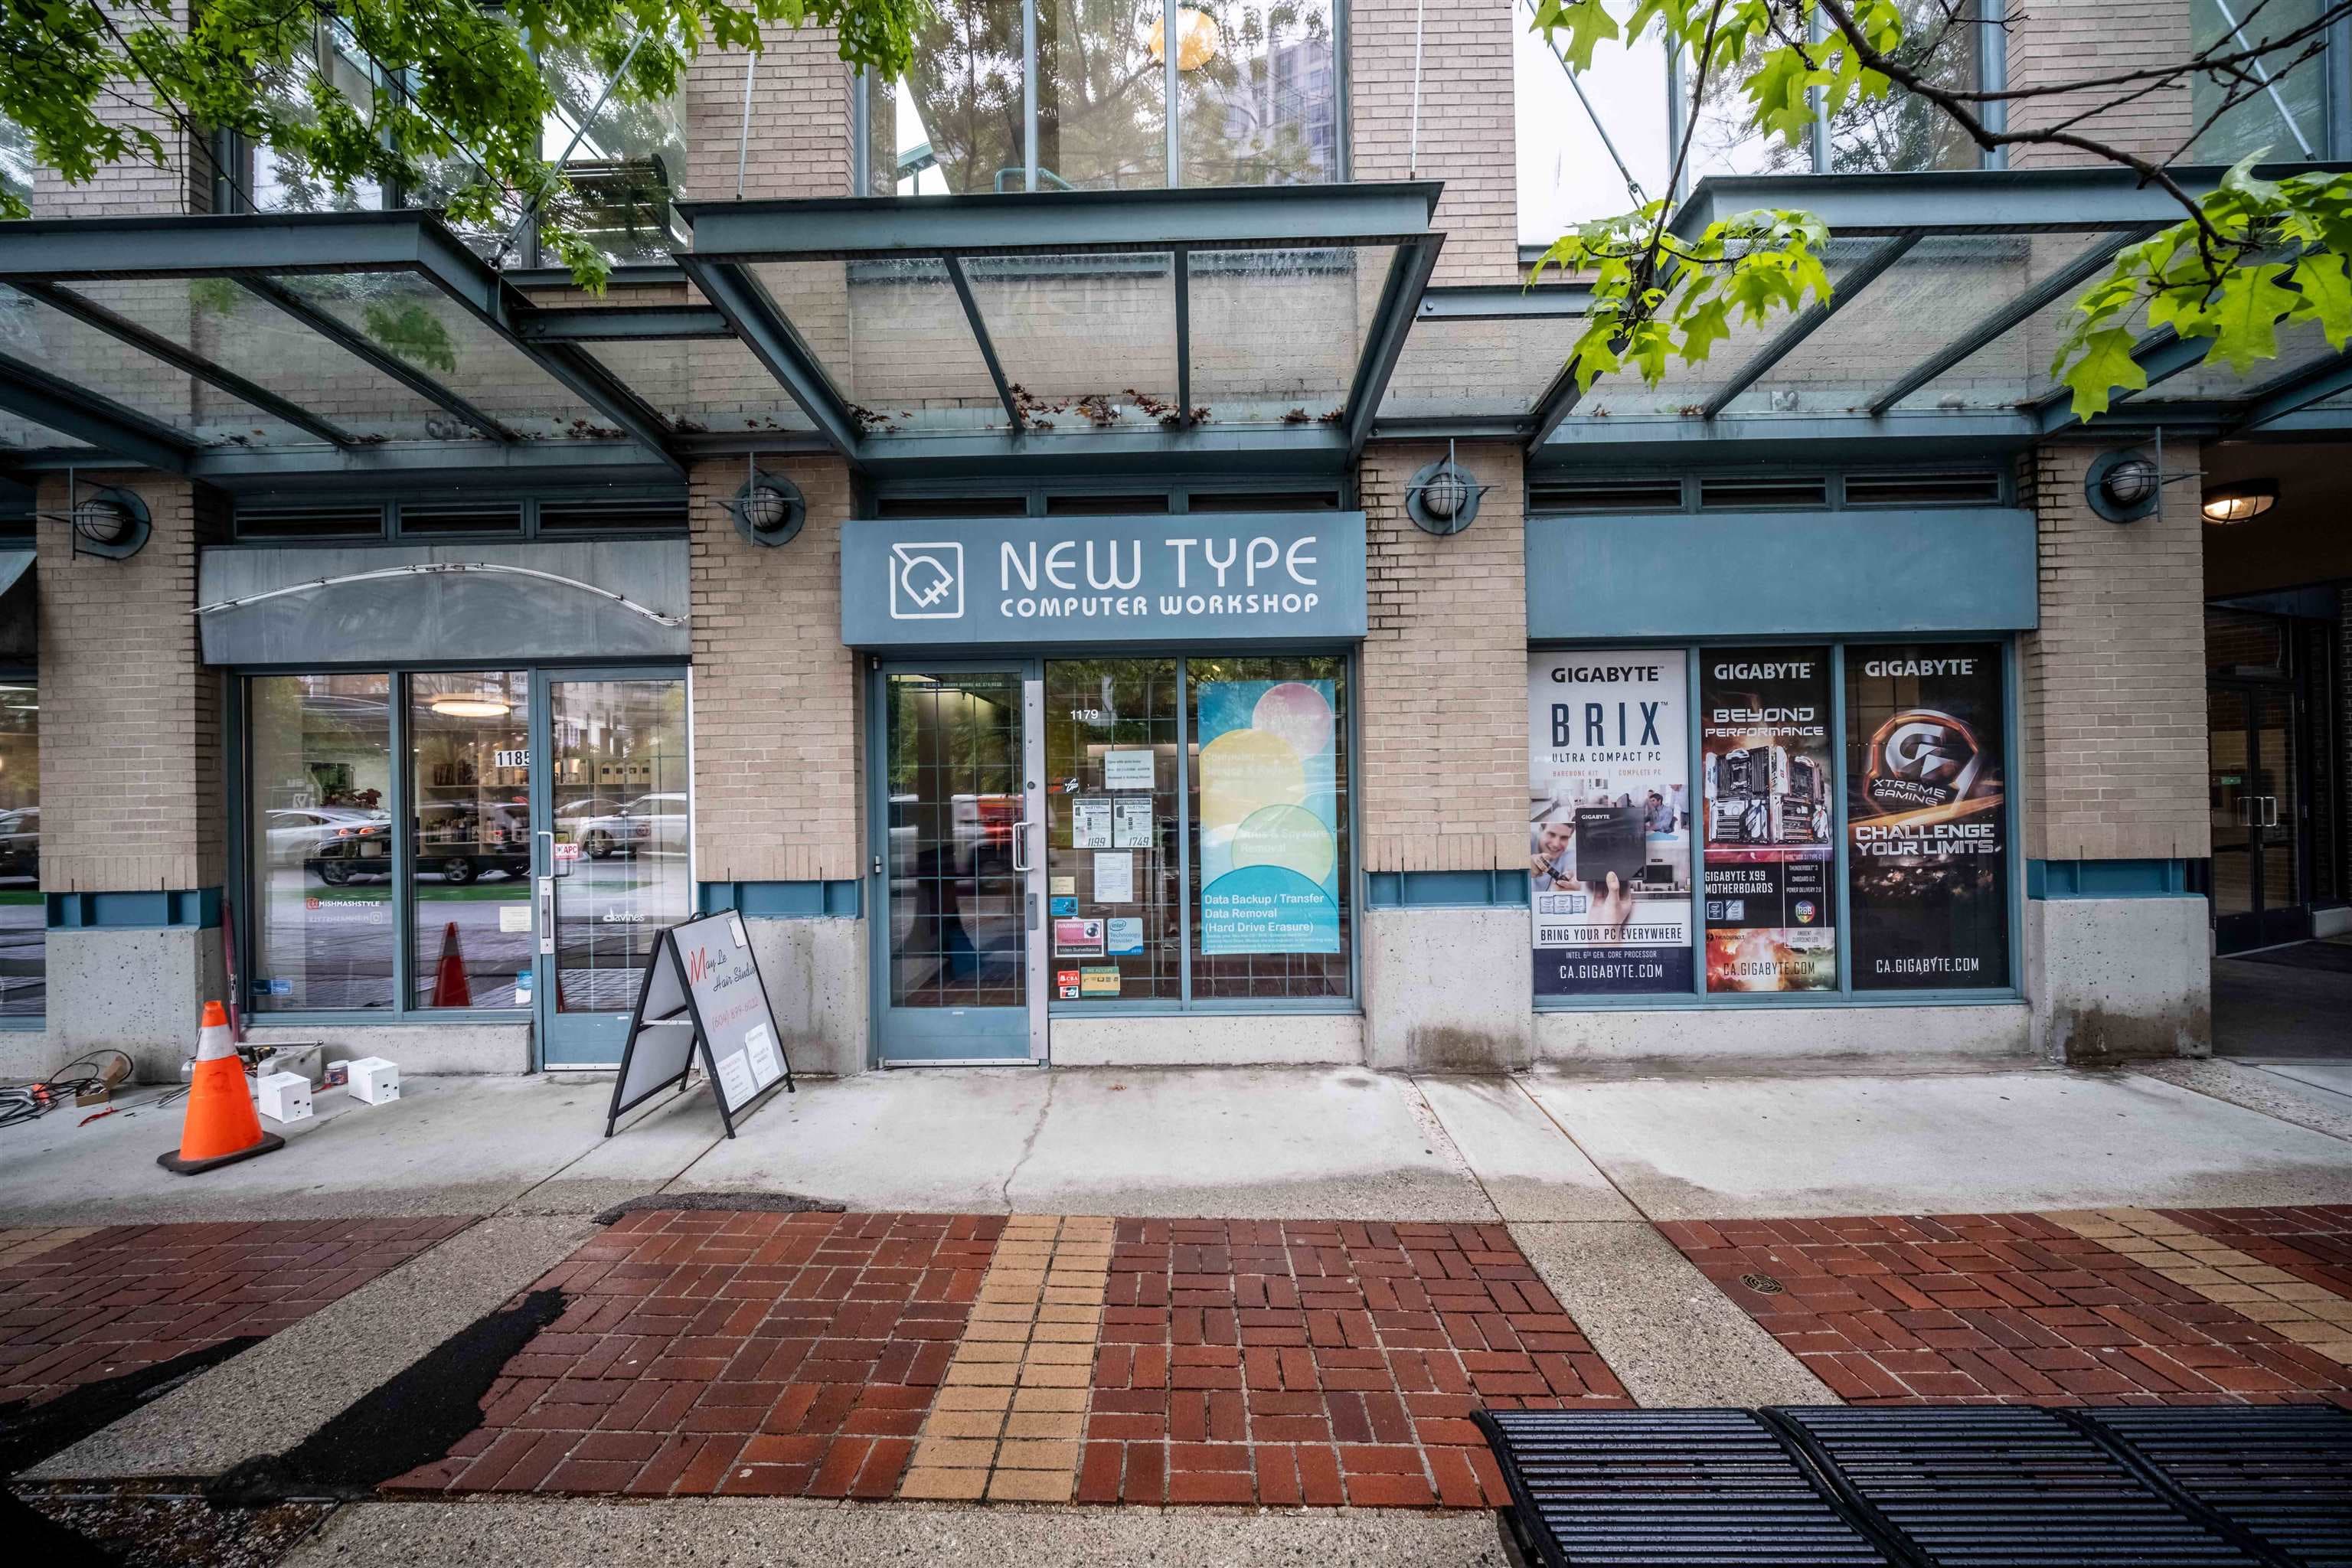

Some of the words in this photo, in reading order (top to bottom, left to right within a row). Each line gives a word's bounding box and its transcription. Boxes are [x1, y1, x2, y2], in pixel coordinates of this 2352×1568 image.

[1001, 539, 1141, 591] NEW
[1165, 536, 1318, 588] TYPE
[1001, 596, 1148, 617] COMPUTER
[1159, 593, 1318, 615] WORKSHOP
[1551, 666, 1659, 683] GIGABYTE
[1714, 662, 1811, 680] GIGABYTE
[1865, 659, 1973, 677] GIGABYTE
[1070, 709, 1099, 720] 1179
[1713, 707, 1815, 723] BEYOND
[1551, 702, 1660, 747] BRIX
[1705, 727, 1824, 737] PERFORMANCE
[498, 751, 530, 766] 1185
[1553, 753, 1585, 763] ULTRA
[1592, 752, 1642, 763] COMPACT
[1648, 751, 1661, 761] PC
[1873, 779, 1947, 798] XTREME
[1874, 789, 1939, 807] GAMING
[1855, 824, 1994, 840] CHALLENGE
[1129, 837, 1150, 847] 1749
[1855, 841, 1919, 856] YOUR
[1705, 871, 1746, 882] GIGABYTE
[1749, 871, 1766, 880] X99
[1705, 883, 1773, 894] MOTHERBOARDS
[1205, 895, 1229, 904] Data
[1232, 894, 1271, 905] Backup
[1274, 894, 1277, 903] /
[1280, 893, 1325, 903] Transfer
[603, 906, 645, 922] davines
[1205, 910, 1229, 919] Data
[1232, 908, 1277, 918] Removal
[1205, 923, 1234, 934] (Hard
[1237, 923, 1265, 932] Drive
[1269, 921, 1314, 933] Erasure)
[1540, 929, 1569, 941] BRING
[1574, 929, 1599, 940] YOUR
[1605, 928, 1616, 939] PC
[1621, 927, 1682, 939] EVERYWHERE
[690, 947, 716, 986] May
[1560, 964, 1663, 979] CA.GIGABYTE.COM
[1723, 962, 1815, 976] CA.GIGABYTE.COM
[1876, 957, 1979, 973] CA.GIGABYTE.COM
[713, 975, 732, 991] Hair
[734, 962, 756, 982] Studio
